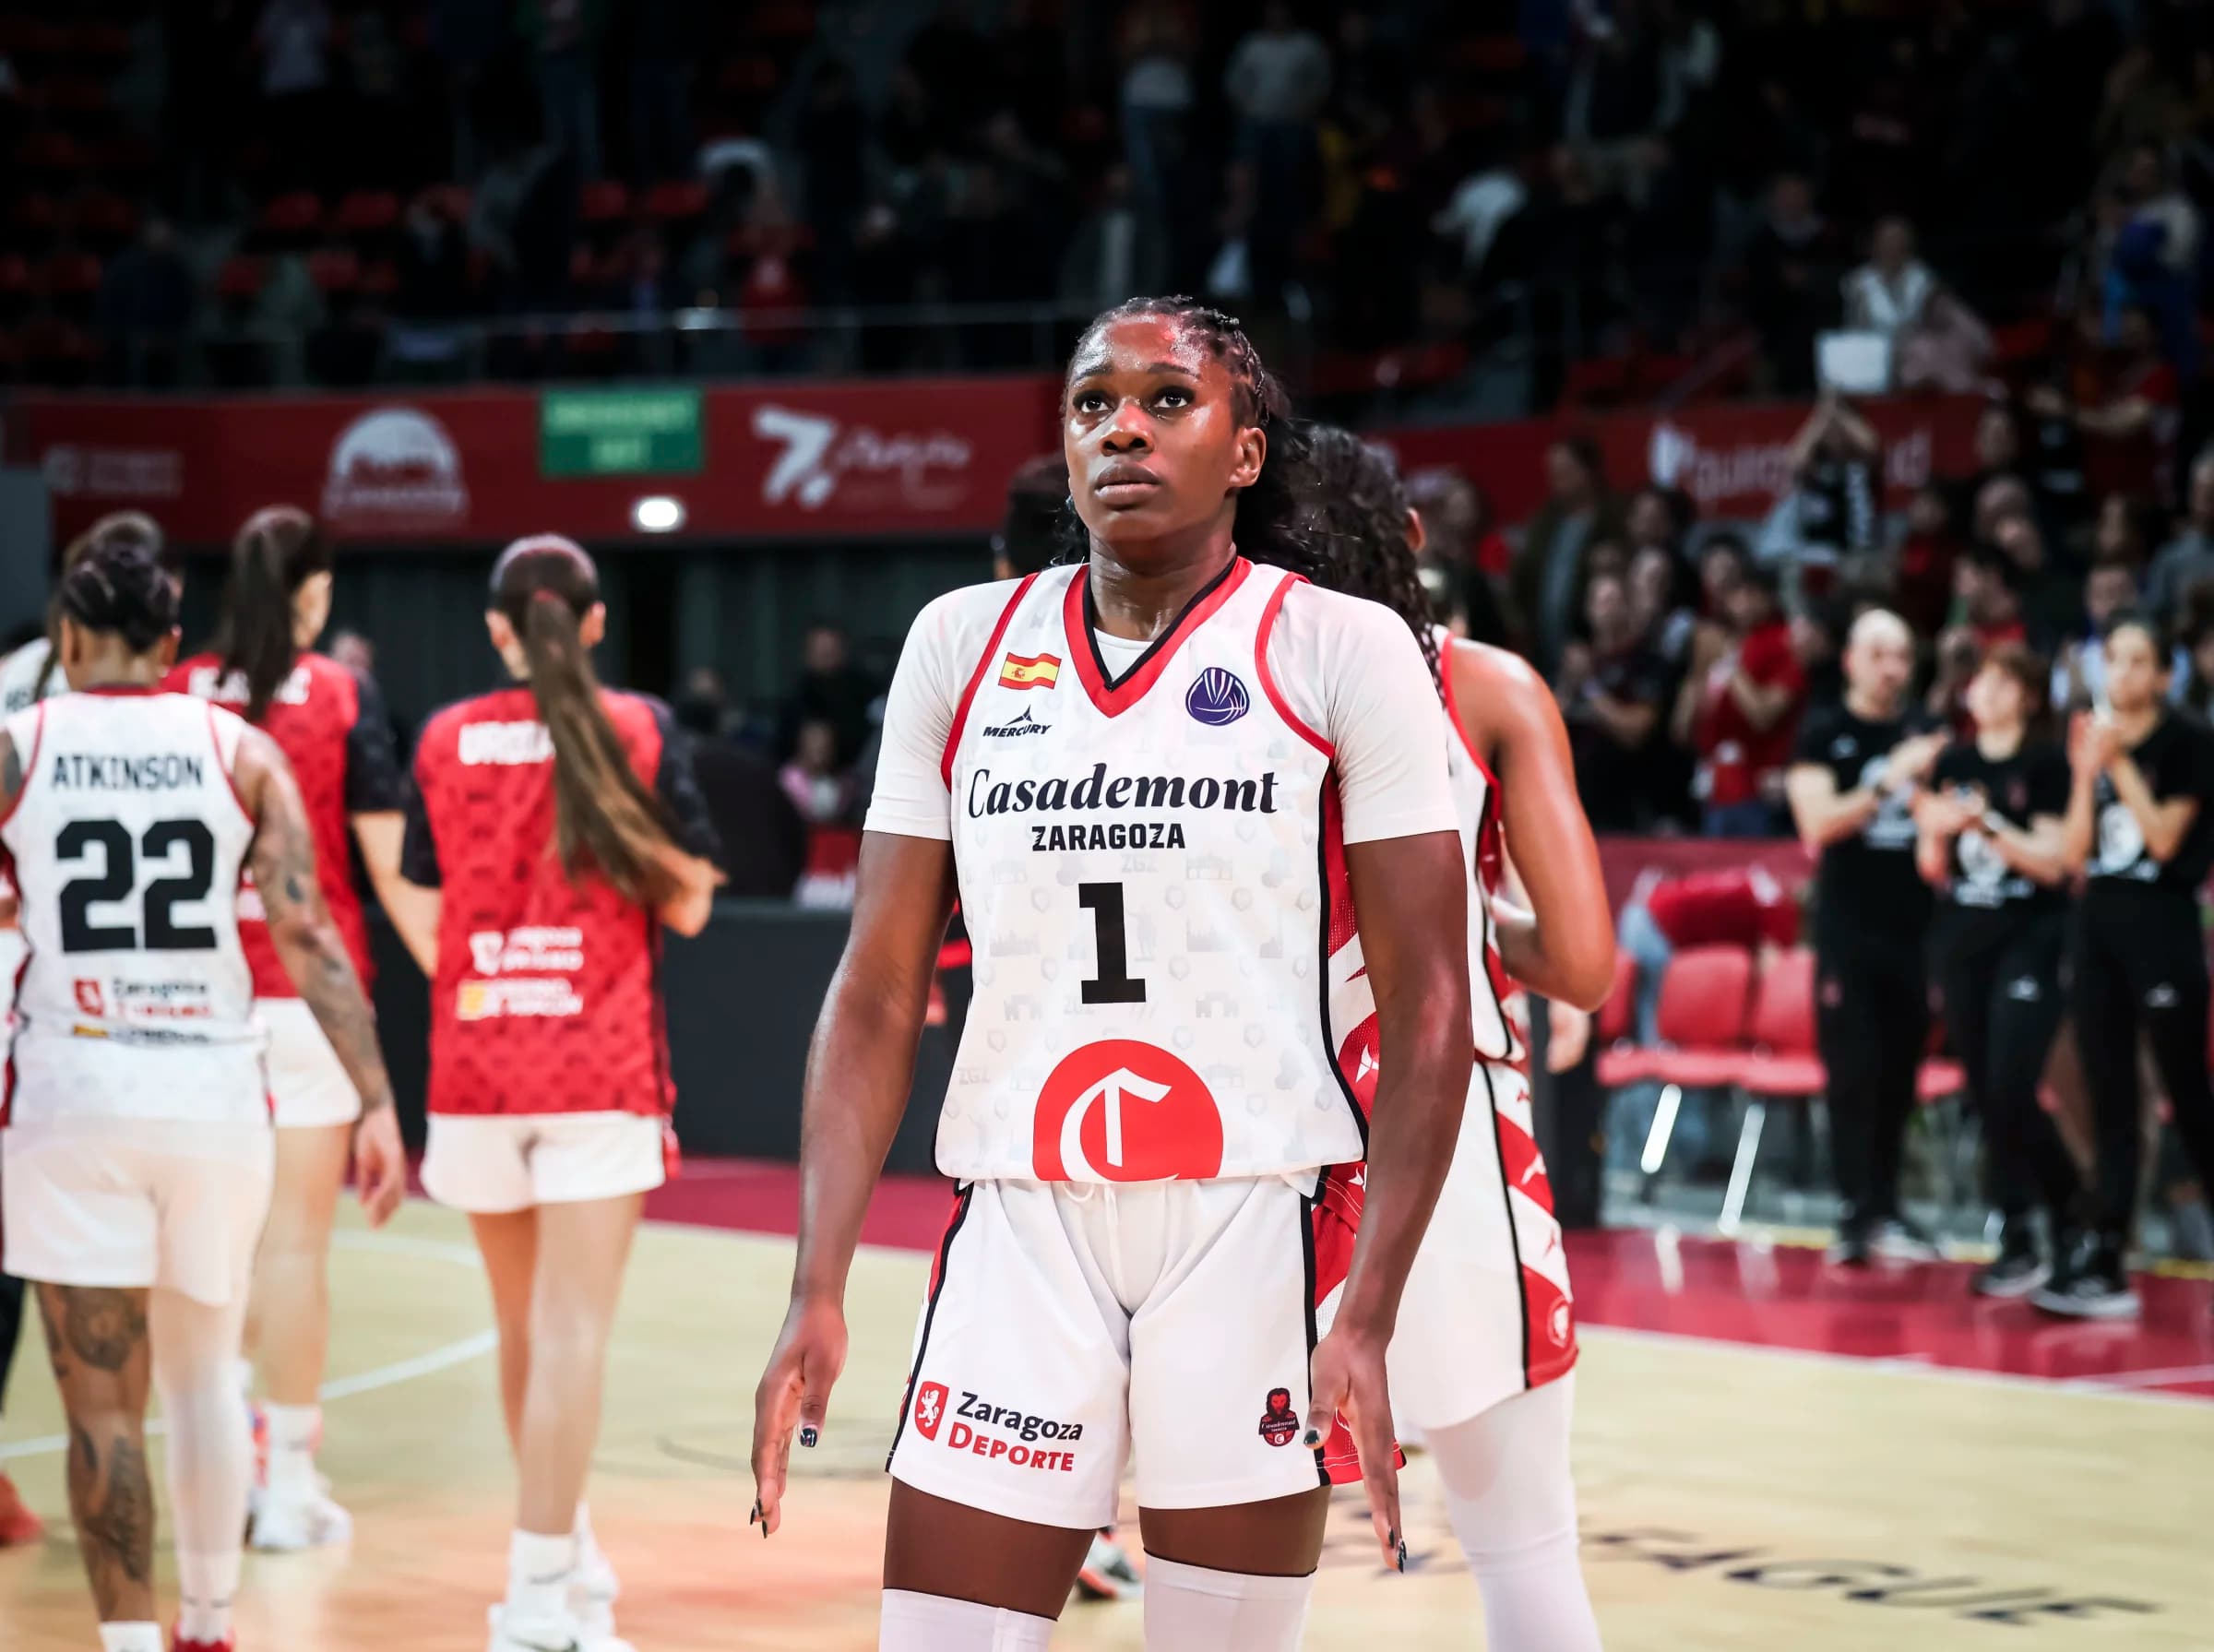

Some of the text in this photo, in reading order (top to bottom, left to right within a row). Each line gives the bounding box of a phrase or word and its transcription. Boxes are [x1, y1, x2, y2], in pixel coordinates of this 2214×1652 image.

[983, 723, 1052, 738] MERCURY
[52, 754, 204, 790] ATKINSON
[969, 763, 1279, 818] Casademont
[1031, 823, 1185, 851] ZARAGOZA
[55, 819, 217, 955] 22
[1077, 882, 1146, 1004] 1
[957, 1391, 1083, 1442] Zaragoza
[948, 1421, 1075, 1473] DEPORTE
